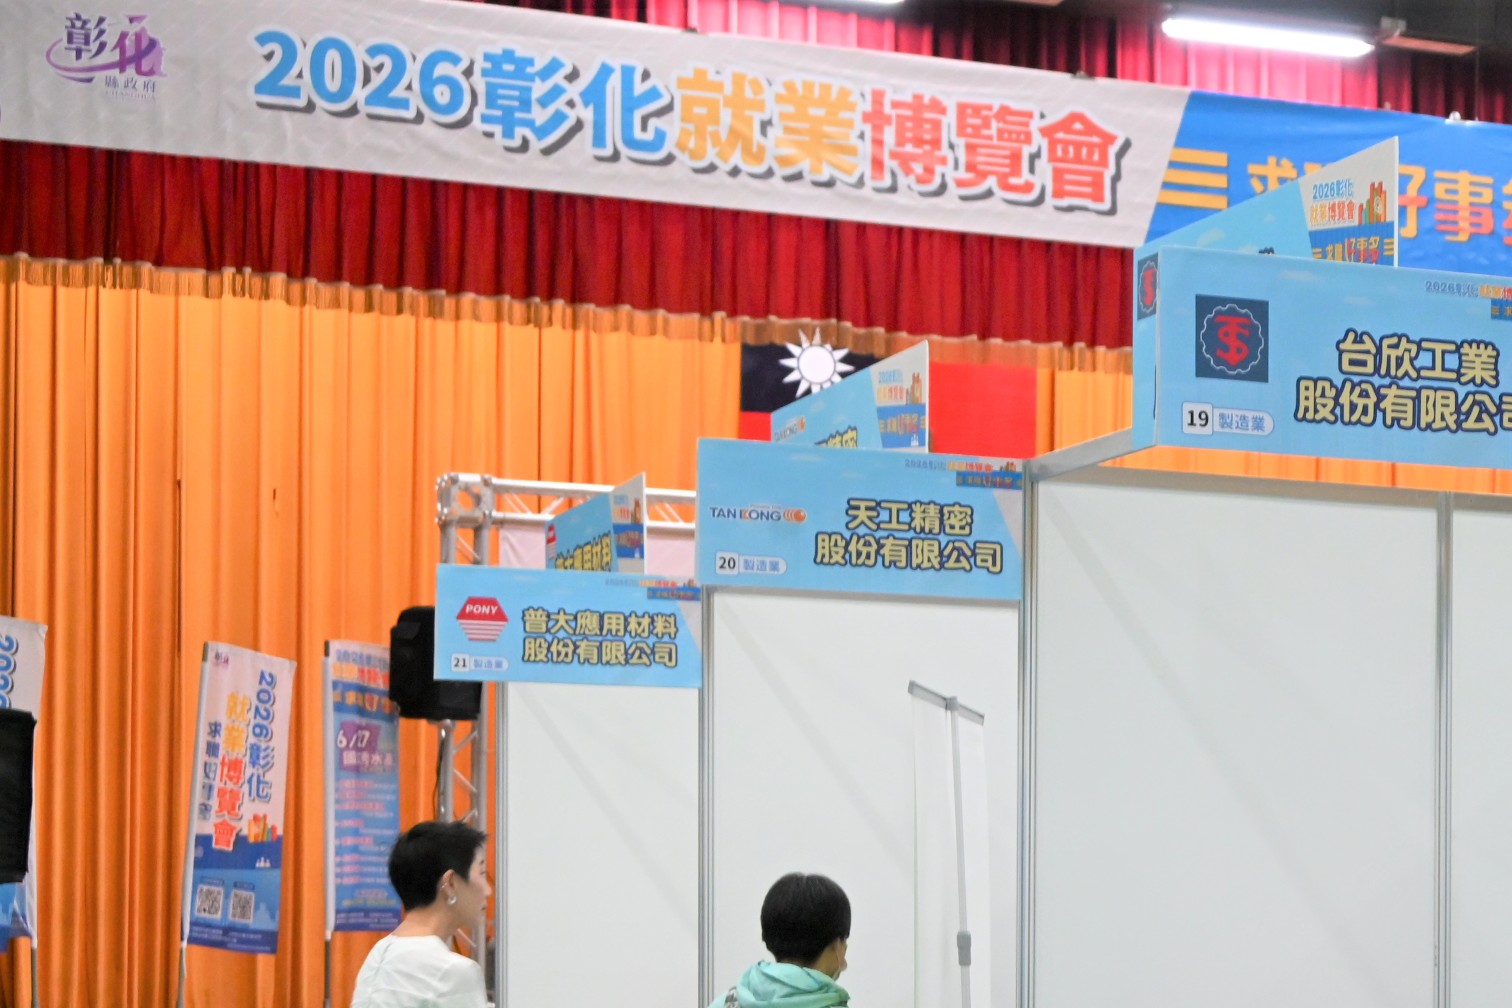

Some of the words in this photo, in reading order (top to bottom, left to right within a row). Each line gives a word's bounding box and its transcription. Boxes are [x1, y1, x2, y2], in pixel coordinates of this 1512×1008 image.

[252, 29, 1124, 207] 2026彰化就業博覽會
[1336, 329, 1499, 386] 台欣工業
[1187, 409, 1209, 427] 19
[1218, 412, 1266, 432] 製造業
[847, 498, 973, 536] 天工精密
[718, 556, 736, 570] 20
[815, 533, 1003, 573] 股份有限公司
[465, 605, 498, 615] PONY
[523, 608, 679, 639] 普大應用材料
[453, 657, 468, 669] 21
[523, 638, 678, 668] 股份有限公司
[247, 669, 275, 802] 2026彰化
[213, 689, 250, 851] 就業博覽會
